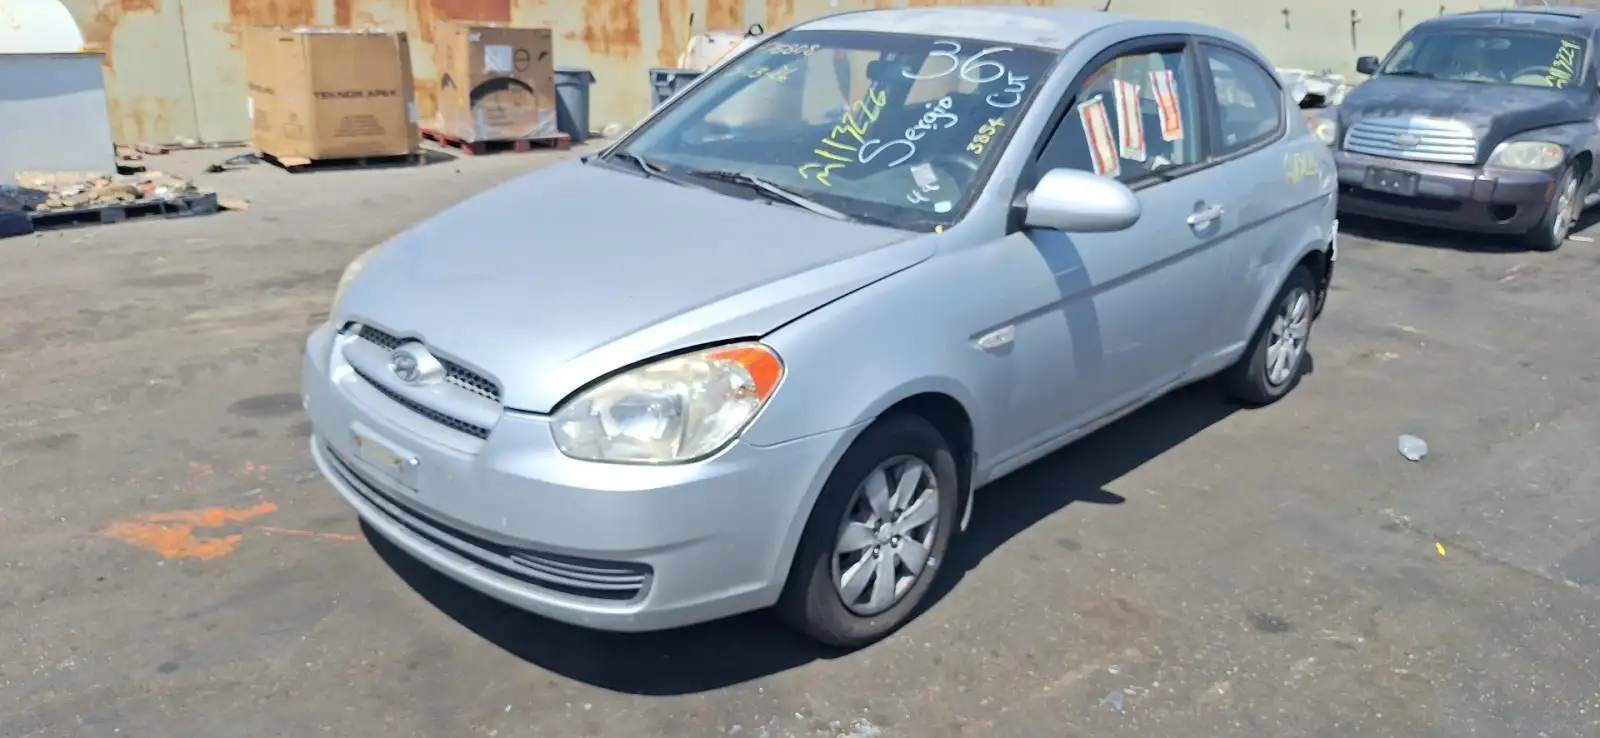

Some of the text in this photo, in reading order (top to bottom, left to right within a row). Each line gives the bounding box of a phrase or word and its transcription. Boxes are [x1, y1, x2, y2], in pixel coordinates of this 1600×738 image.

[902, 41, 1014, 83] 36
[314, 88, 396, 99] TEKNOR APEX
[858, 95, 958, 167] Sergio
